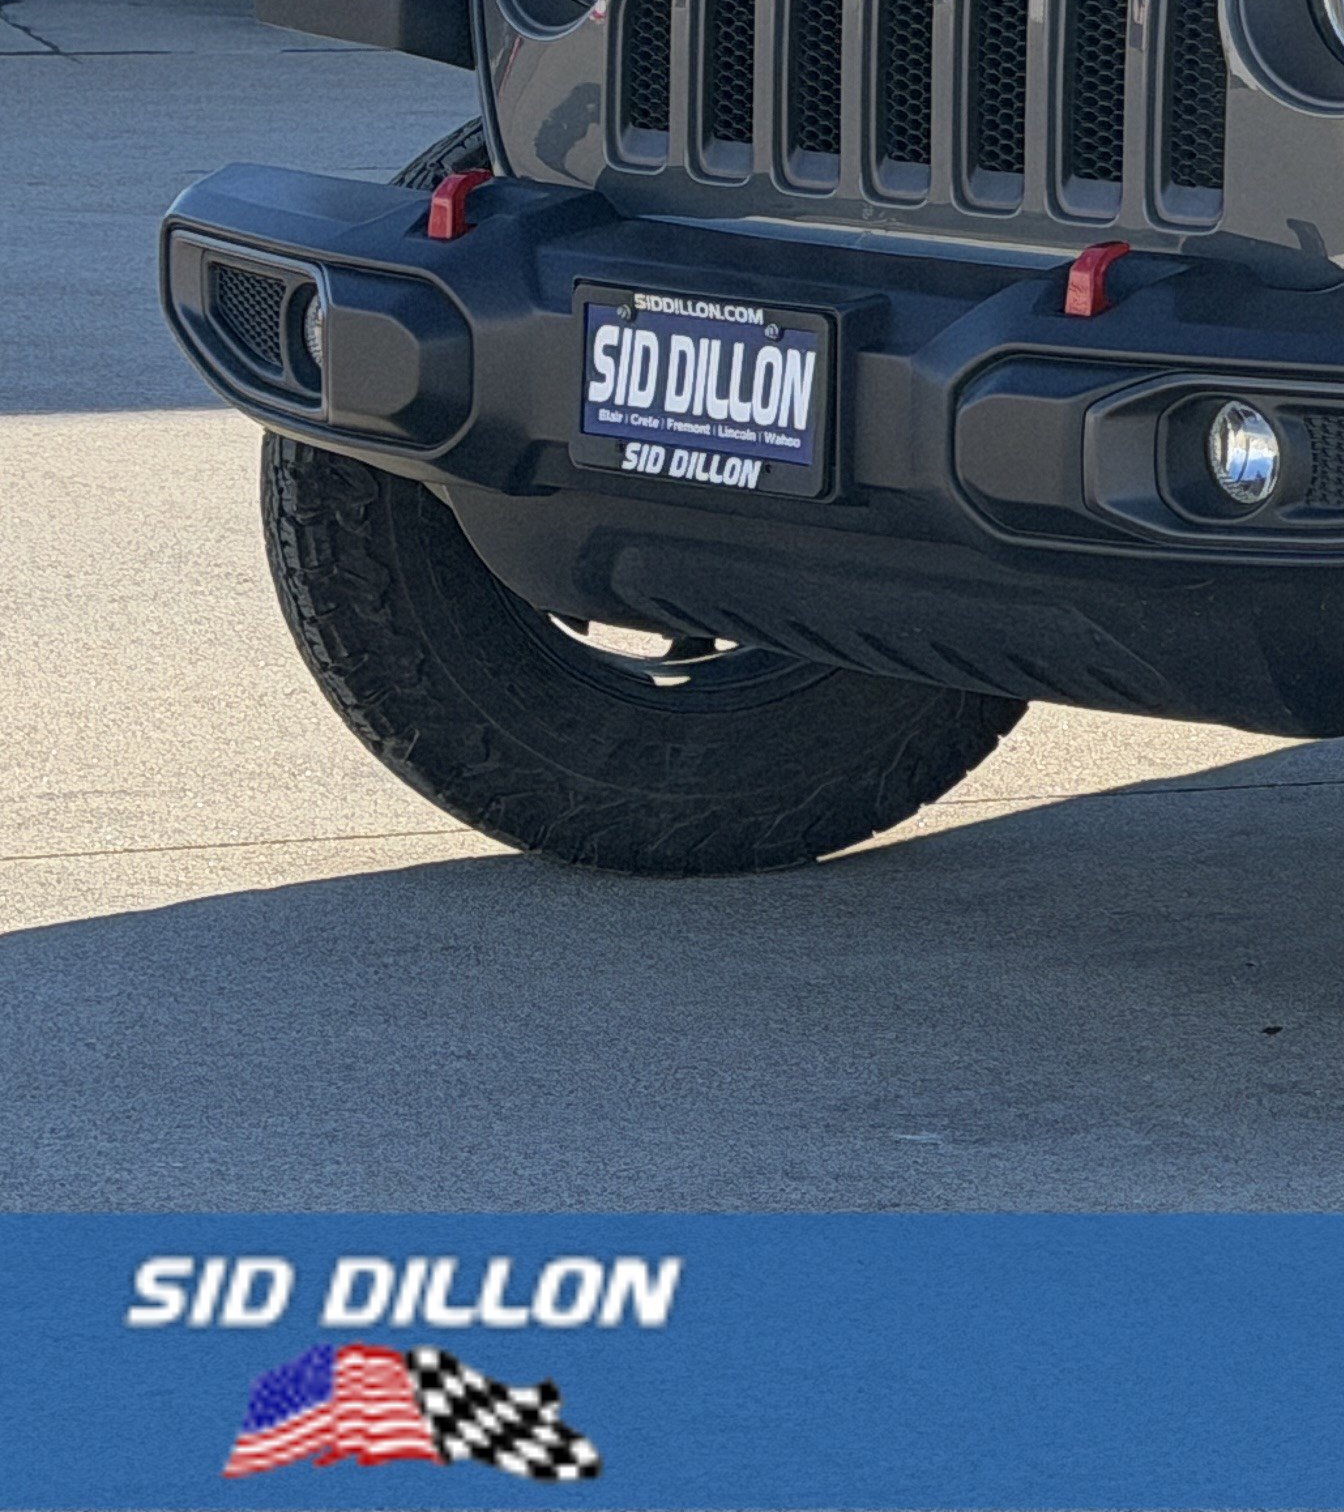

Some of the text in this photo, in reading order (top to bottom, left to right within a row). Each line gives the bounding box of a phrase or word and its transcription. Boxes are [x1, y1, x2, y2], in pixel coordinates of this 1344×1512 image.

[633, 293, 764, 325] SIDDILLON.COM
[588, 324, 816, 431] SID DILLON
[598, 408, 801, 448] Blair Crete Fremont Lincoln Wahoo
[621, 441, 762, 489] SID DILLON
